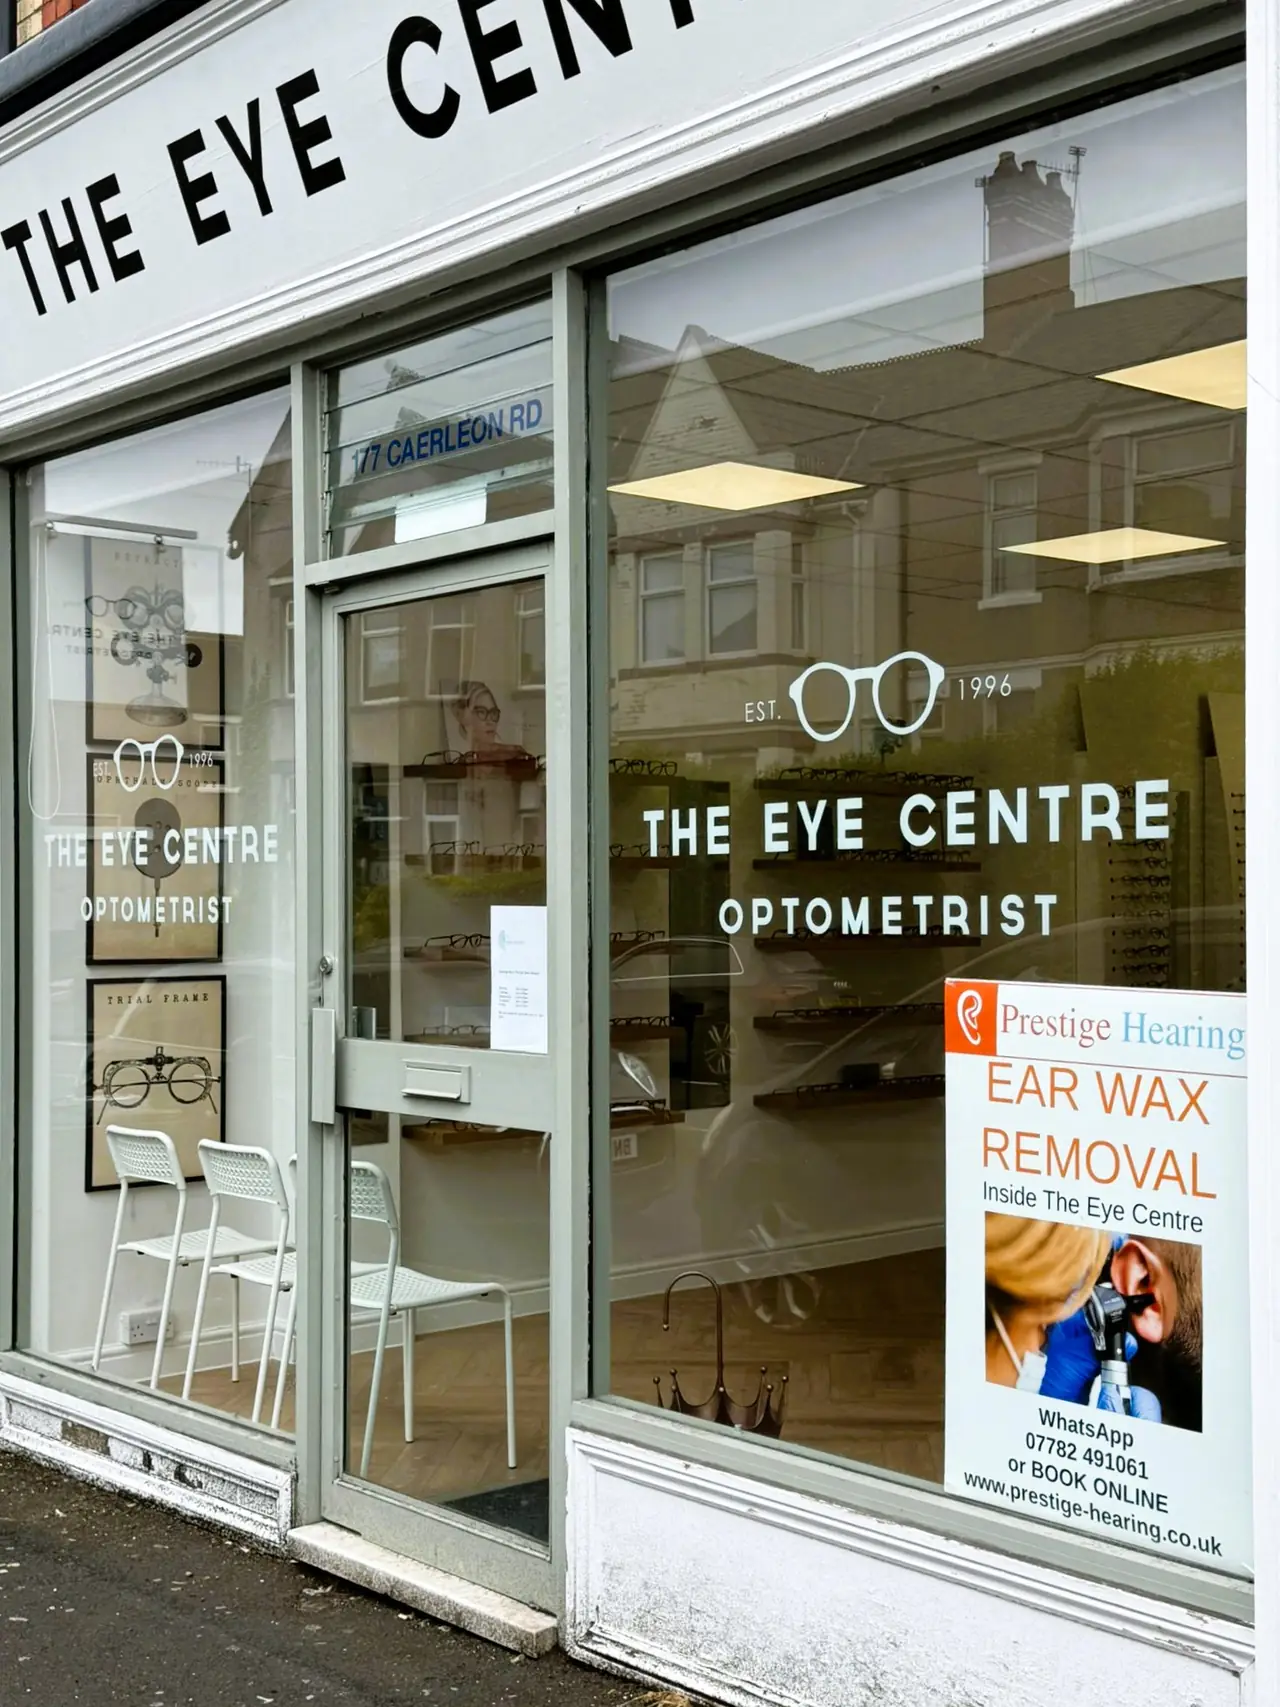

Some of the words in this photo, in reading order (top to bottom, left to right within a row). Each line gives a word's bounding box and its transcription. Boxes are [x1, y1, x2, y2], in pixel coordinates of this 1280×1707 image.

[1, 173, 146, 316] THE
[166, 68, 347, 246] EYE
[352, 444, 381, 474] 177
[387, 409, 503, 468] CAERLEON
[509, 398, 543, 433] RD
[744, 700, 782, 723] EST.
[957, 674, 1012, 700] 1996
[189, 752, 214, 769] 1996
[643, 805, 730, 857] THE
[763, 797, 864, 853] EYE
[899, 779, 1170, 847] CENTRE
[44, 833, 87, 867] THE
[102, 830, 149, 866] EYE
[164, 824, 280, 864] CENTRE
[80, 896, 233, 924] OPTOMETRIST
[718, 894, 1058, 936] OPTOMETRIST
[107, 994, 152, 1005] TRIAL
[163, 992, 209, 1003] FRAME
[1000, 1003, 1112, 1049] Prestige
[1121, 1011, 1246, 1061] Hearing
[988, 1061, 1079, 1111] EAR
[1095, 1071, 1210, 1125] WAX
[983, 1127, 1217, 1200] REMOVAL
[983, 1181, 1037, 1208] Inside
[1043, 1190, 1080, 1214] The
[1087, 1196, 1125, 1224] Eye
[1132, 1203, 1204, 1233] Centre
[1039, 1408, 1134, 1448] WhatsApp
[1025, 1432, 1077, 1461] 07782
[1083, 1447, 1149, 1480] 491061
[1008, 1457, 1026, 1474] or
[1032, 1461, 1087, 1491] BOOK
[1093, 1477, 1169, 1513] ONLINE
[964, 1471, 1223, 1557] www.prestige-hearing.co.uk
